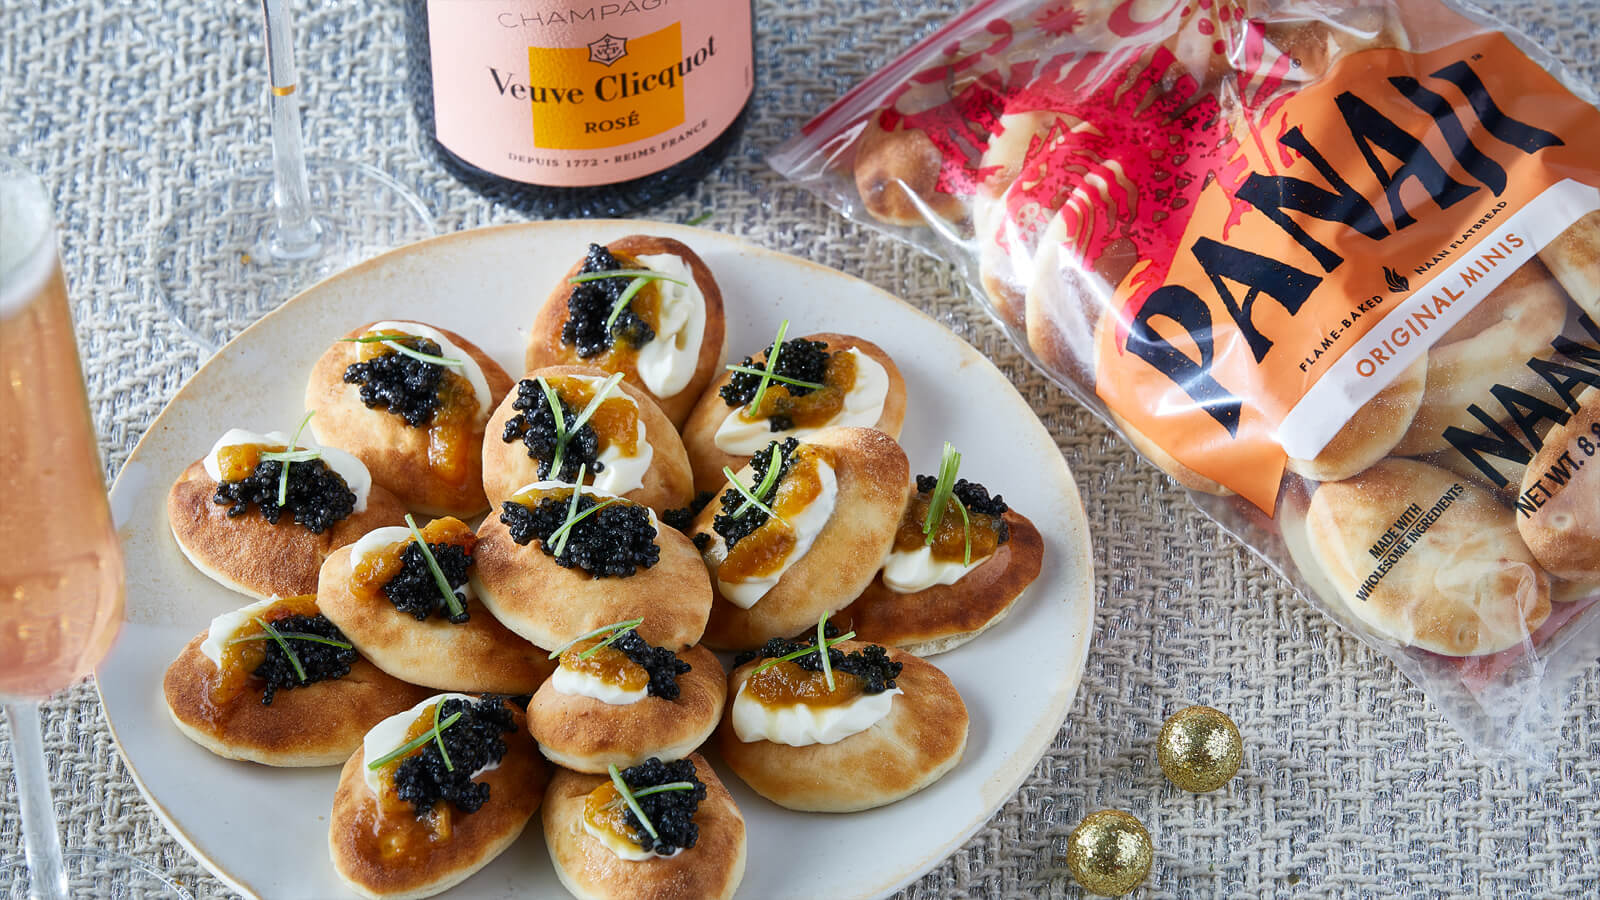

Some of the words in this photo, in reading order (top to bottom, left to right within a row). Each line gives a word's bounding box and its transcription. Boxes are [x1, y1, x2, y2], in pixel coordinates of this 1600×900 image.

[498, 0, 668, 28] CHAMPAG
[486, 66, 584, 104] Veuve
[595, 35, 718, 103] Clicquot
[508, 152, 559, 167] DEPUIS
[566, 159, 598, 168] 1772
[614, 146, 657, 163] REIMS
[661, 118, 708, 151] FRANCE
[584, 110, 640, 134] ROSÉ
[1126, 60, 1566, 438] PANAJI
[1299, 295, 1384, 372] FLAME-BAKED
[1414, 249, 1451, 275] NAAN
[1449, 200, 1508, 249] FLATBREAD
[1356, 286, 1465, 377] ORIGINAL
[1459, 233, 1524, 288] MINIS
[1515, 479, 1552, 519] NET
[1544, 450, 1584, 486] WT.
[1355, 541, 1412, 602] WHOLESOME
[1406, 483, 1464, 544] INGREDIENTS
[1368, 527, 1400, 559] MADE
[1393, 502, 1422, 531] WITH
